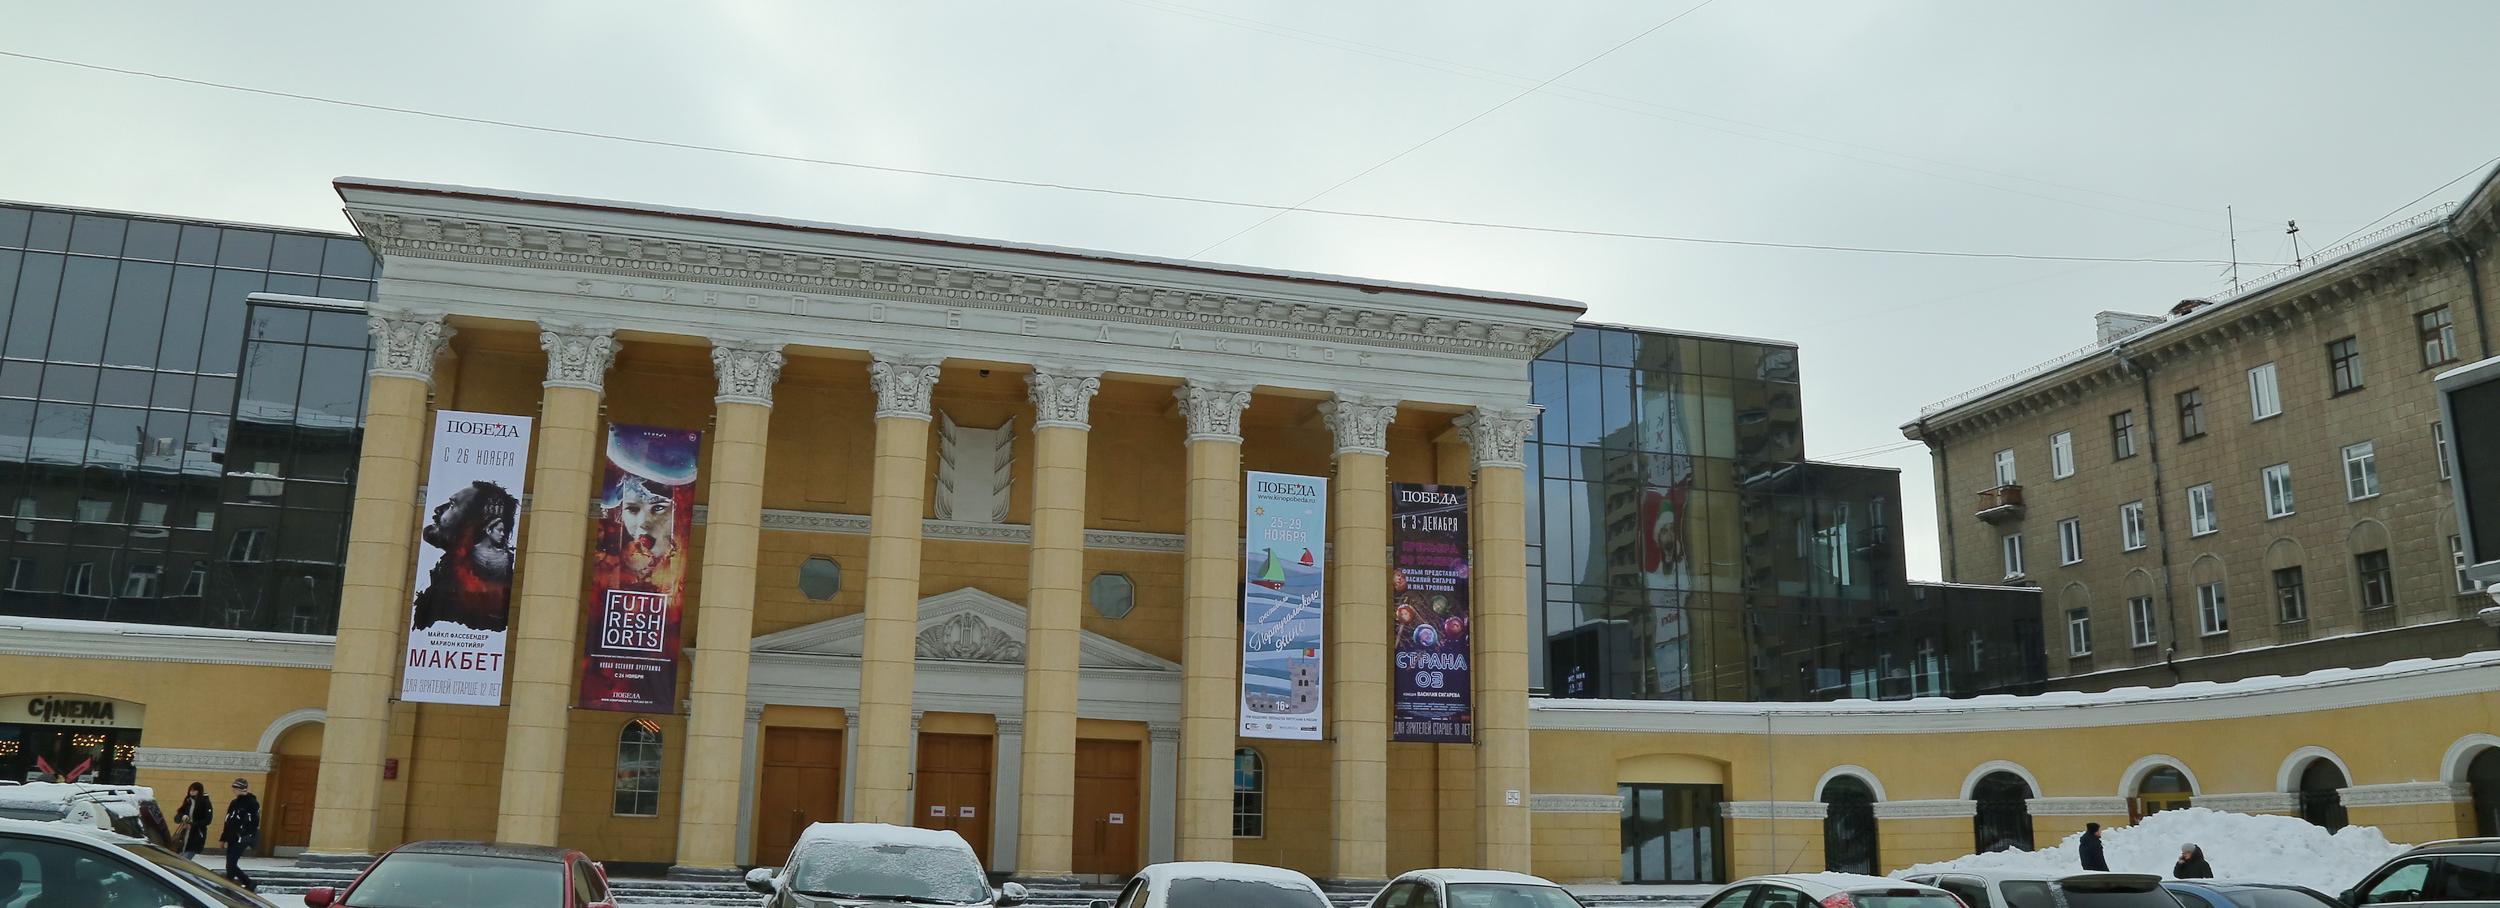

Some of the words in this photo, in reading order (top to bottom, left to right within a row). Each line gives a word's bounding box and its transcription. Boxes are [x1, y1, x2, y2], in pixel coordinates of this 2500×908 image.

[446, 420, 520, 438] ПОБЕДА
[443, 446, 450, 462] С
[456, 448, 469, 464] 26
[476, 449, 515, 467] НОЯБРЯ
[1257, 481, 1316, 497] ПОБЕДА
[1401, 490, 1459, 505] ПОБЕДА
[1271, 516, 1302, 530] 25-29
[1401, 514, 1406, 529] С
[1412, 515, 1417, 529] 3
[1422, 516, 1458, 532] ДЕКАБРЯ
[1264, 528, 1306, 543] НОЯБРЯ
[611, 594, 663, 613] FUTU
[609, 611, 661, 630] RESH
[450, 633, 489, 641] ФАССБЕНДЕР
[607, 628, 658, 647] ORTS
[409, 648, 503, 672] МАКБЕТ
[1396, 651, 1467, 671] СТРАНА
[403, 678, 418, 693] ДЛЯ
[420, 678, 452, 695] ЗРИТЕЛЕЙ
[452, 680, 479, 696] СТАРШЕ
[480, 682, 487, 696] 12
[488, 682, 501, 697] ЛЕТ
[612, 691, 641, 699] ПОБЕДА
[1394, 721, 1404, 735] ДЛЯ
[1405, 721, 1432, 735] ЗРИТЕЛЕЙ
[1432, 722, 1453, 736] СТАРШЕ
[1461, 723, 1471, 736] ЛЕТ
